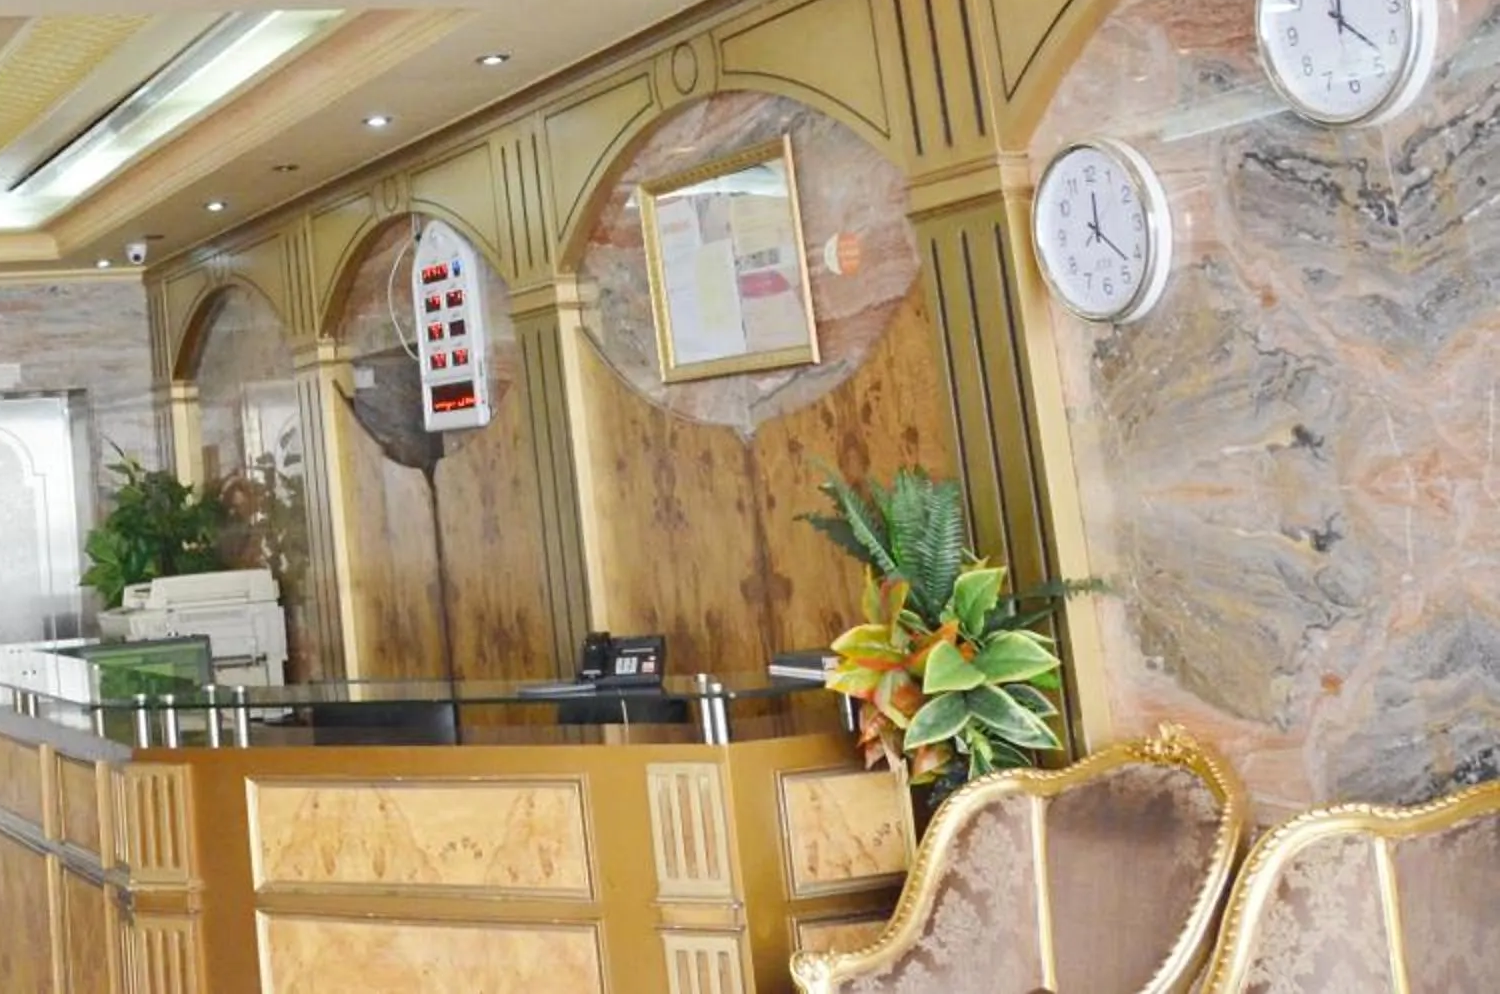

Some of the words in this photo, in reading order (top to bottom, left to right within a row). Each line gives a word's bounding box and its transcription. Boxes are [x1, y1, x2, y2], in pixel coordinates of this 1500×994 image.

[1287, 27, 1298, 46] 9
[1303, 56, 1313, 76] 8
[1321, 71, 1332, 91] 7
[1105, 170, 1112, 183] 1
[1121, 185, 1132, 203] 2
[1132, 213, 1142, 231] 3
[1084, 272, 1092, 289] 7
[1121, 266, 1131, 284] 5
[1103, 277, 1113, 295] 6
